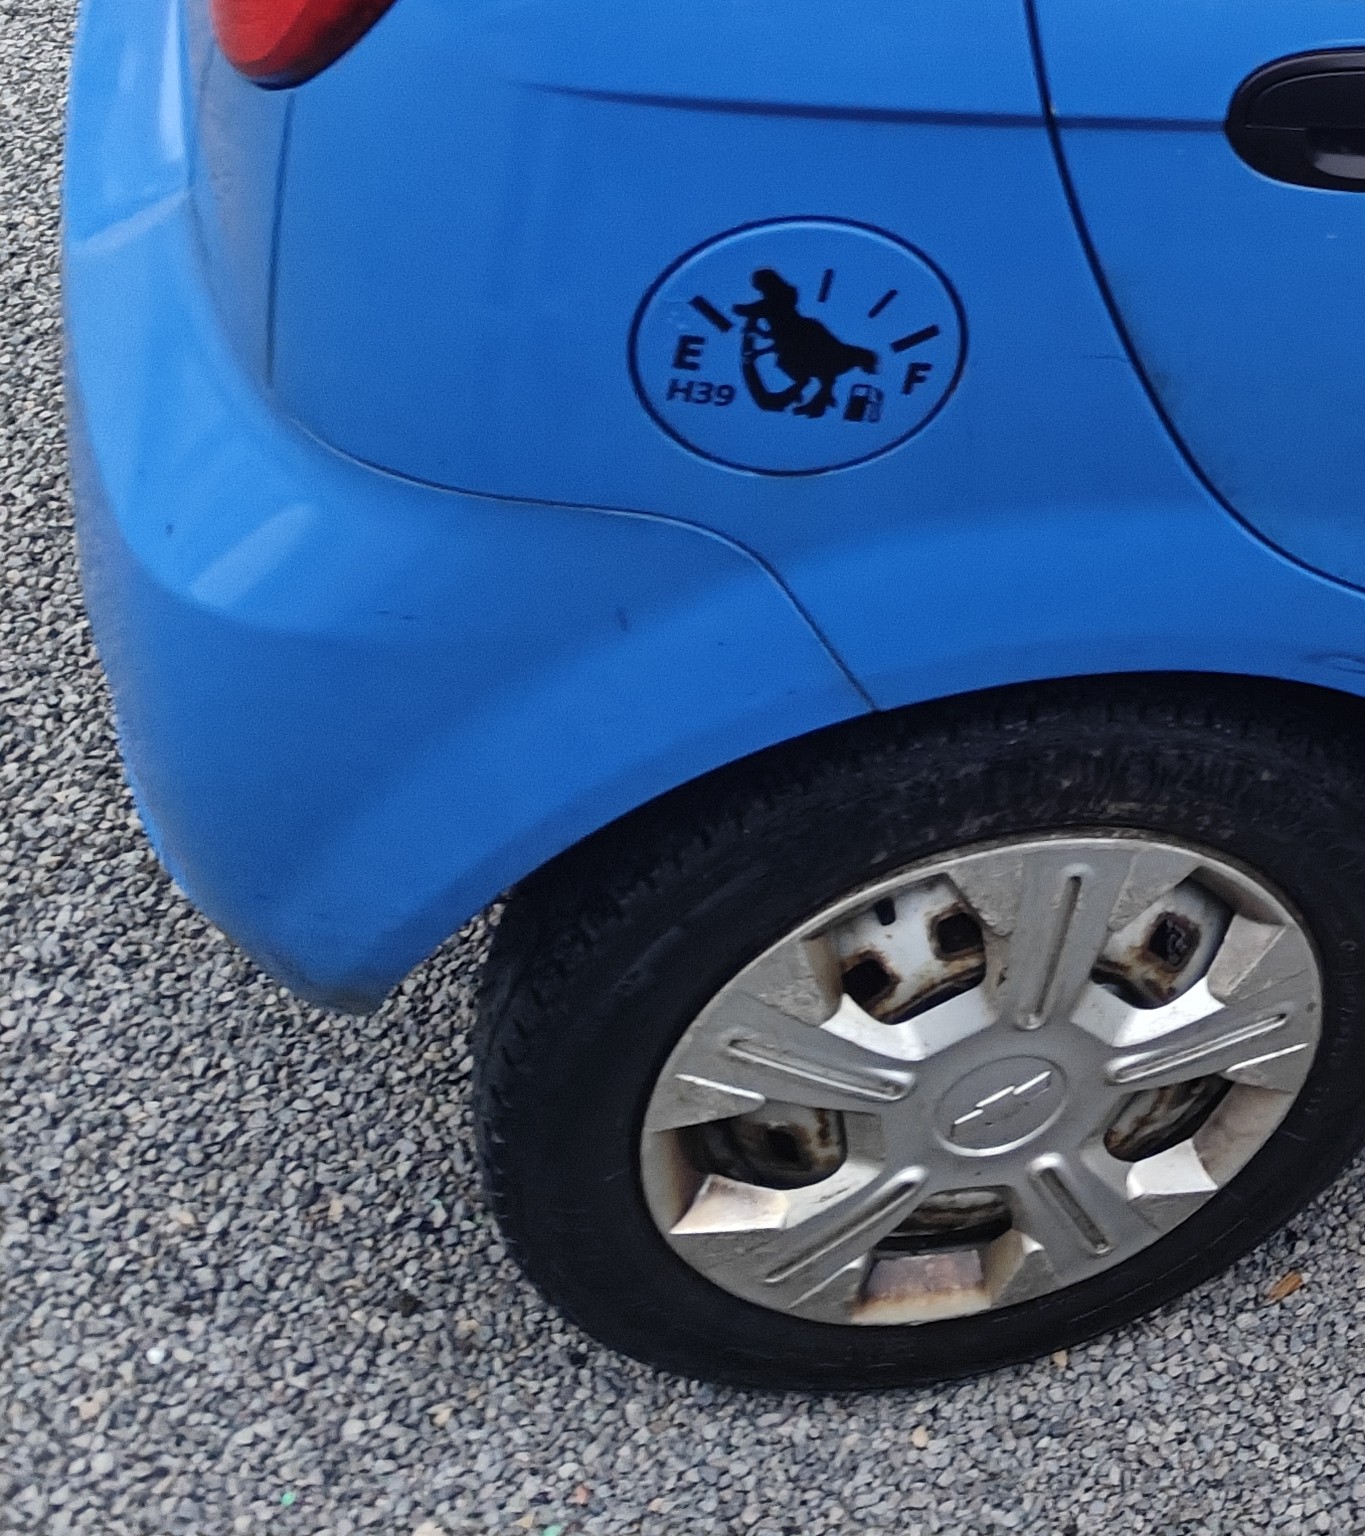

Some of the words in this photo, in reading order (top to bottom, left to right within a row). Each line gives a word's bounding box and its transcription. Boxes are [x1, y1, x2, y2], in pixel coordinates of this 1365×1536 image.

[672, 335, 706, 371] E
[666, 379, 737, 407] H39
[901, 363, 933, 396] F
